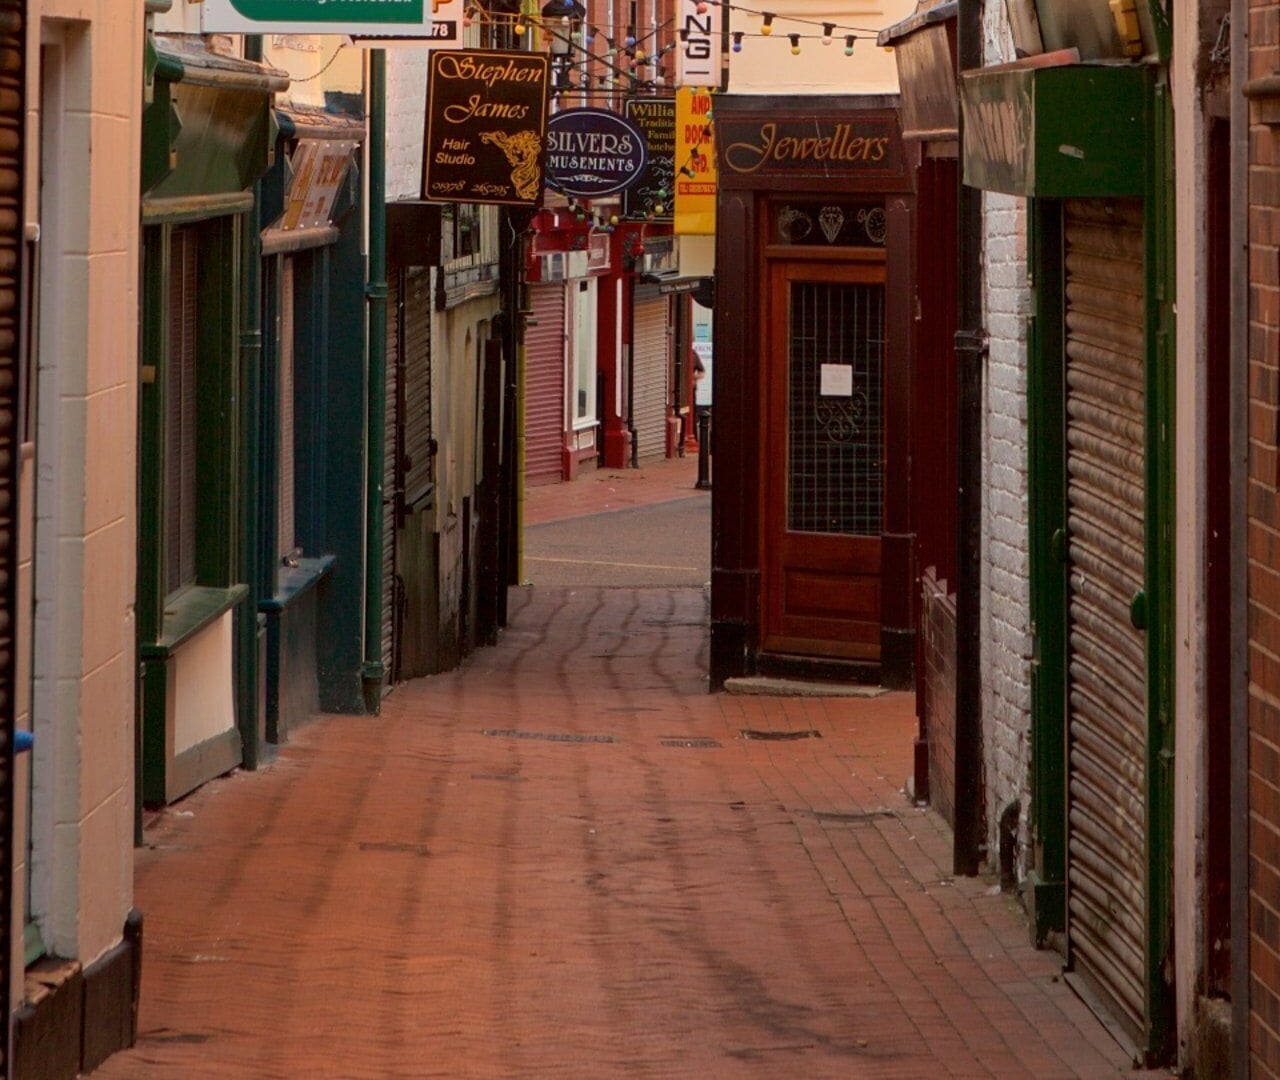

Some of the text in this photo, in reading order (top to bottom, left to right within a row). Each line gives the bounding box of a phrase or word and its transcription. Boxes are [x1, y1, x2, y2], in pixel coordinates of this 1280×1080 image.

[437, 55, 543, 88] Stephen
[443, 94, 530, 124] James
[442, 137, 471, 151] Hair
[546, 130, 633, 156] SILVERS
[725, 123, 889, 173] Jewellers
[435, 152, 476, 165] Studio
[546, 155, 635, 172] MUSEMENTS
